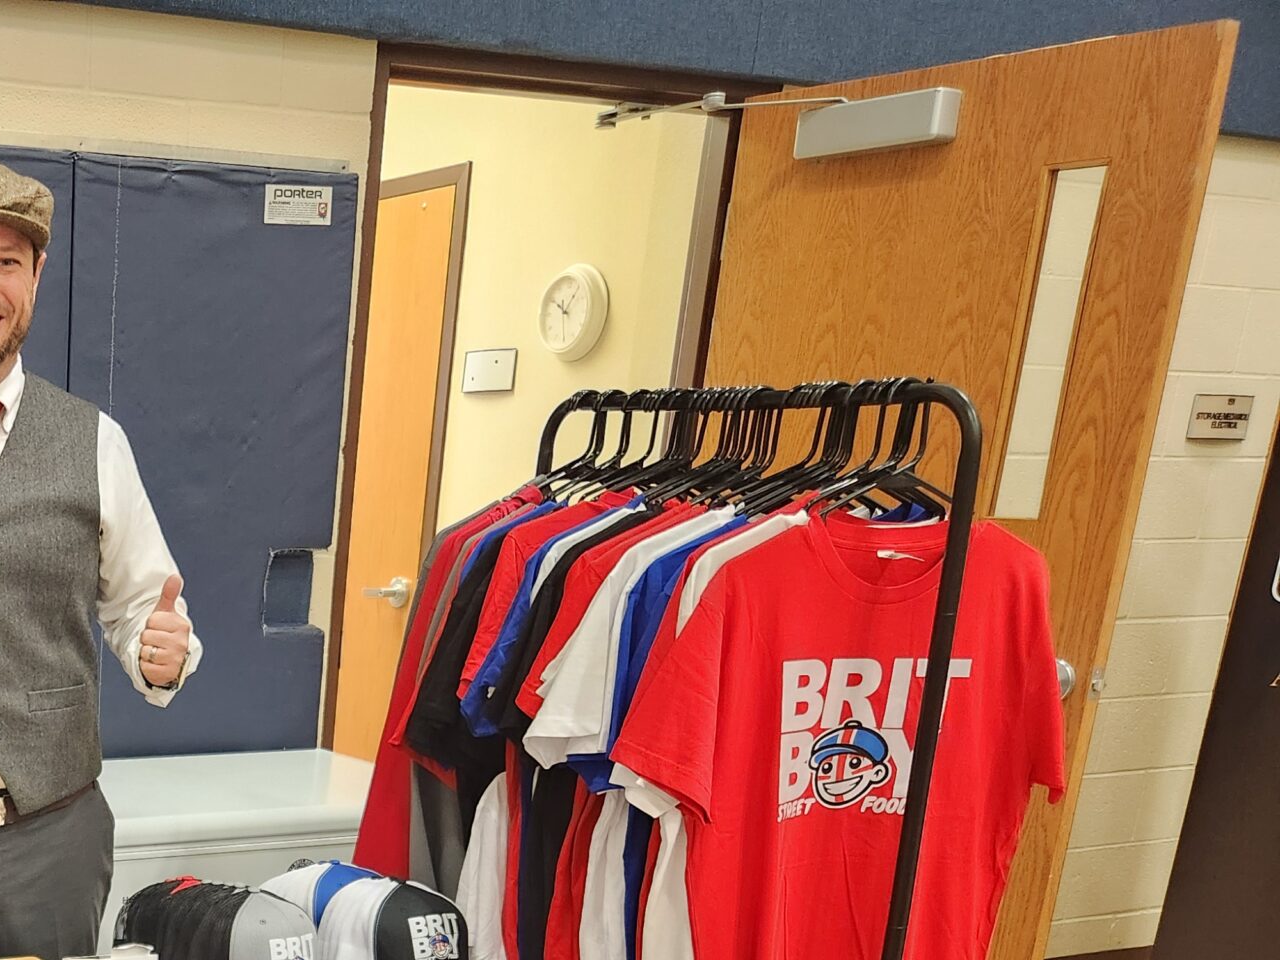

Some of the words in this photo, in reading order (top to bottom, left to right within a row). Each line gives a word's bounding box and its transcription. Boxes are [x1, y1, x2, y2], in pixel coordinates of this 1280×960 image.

[777, 796, 816, 823] STREET
[408, 913, 458, 939] BRIT
[269, 933, 313, 960] BRIT
